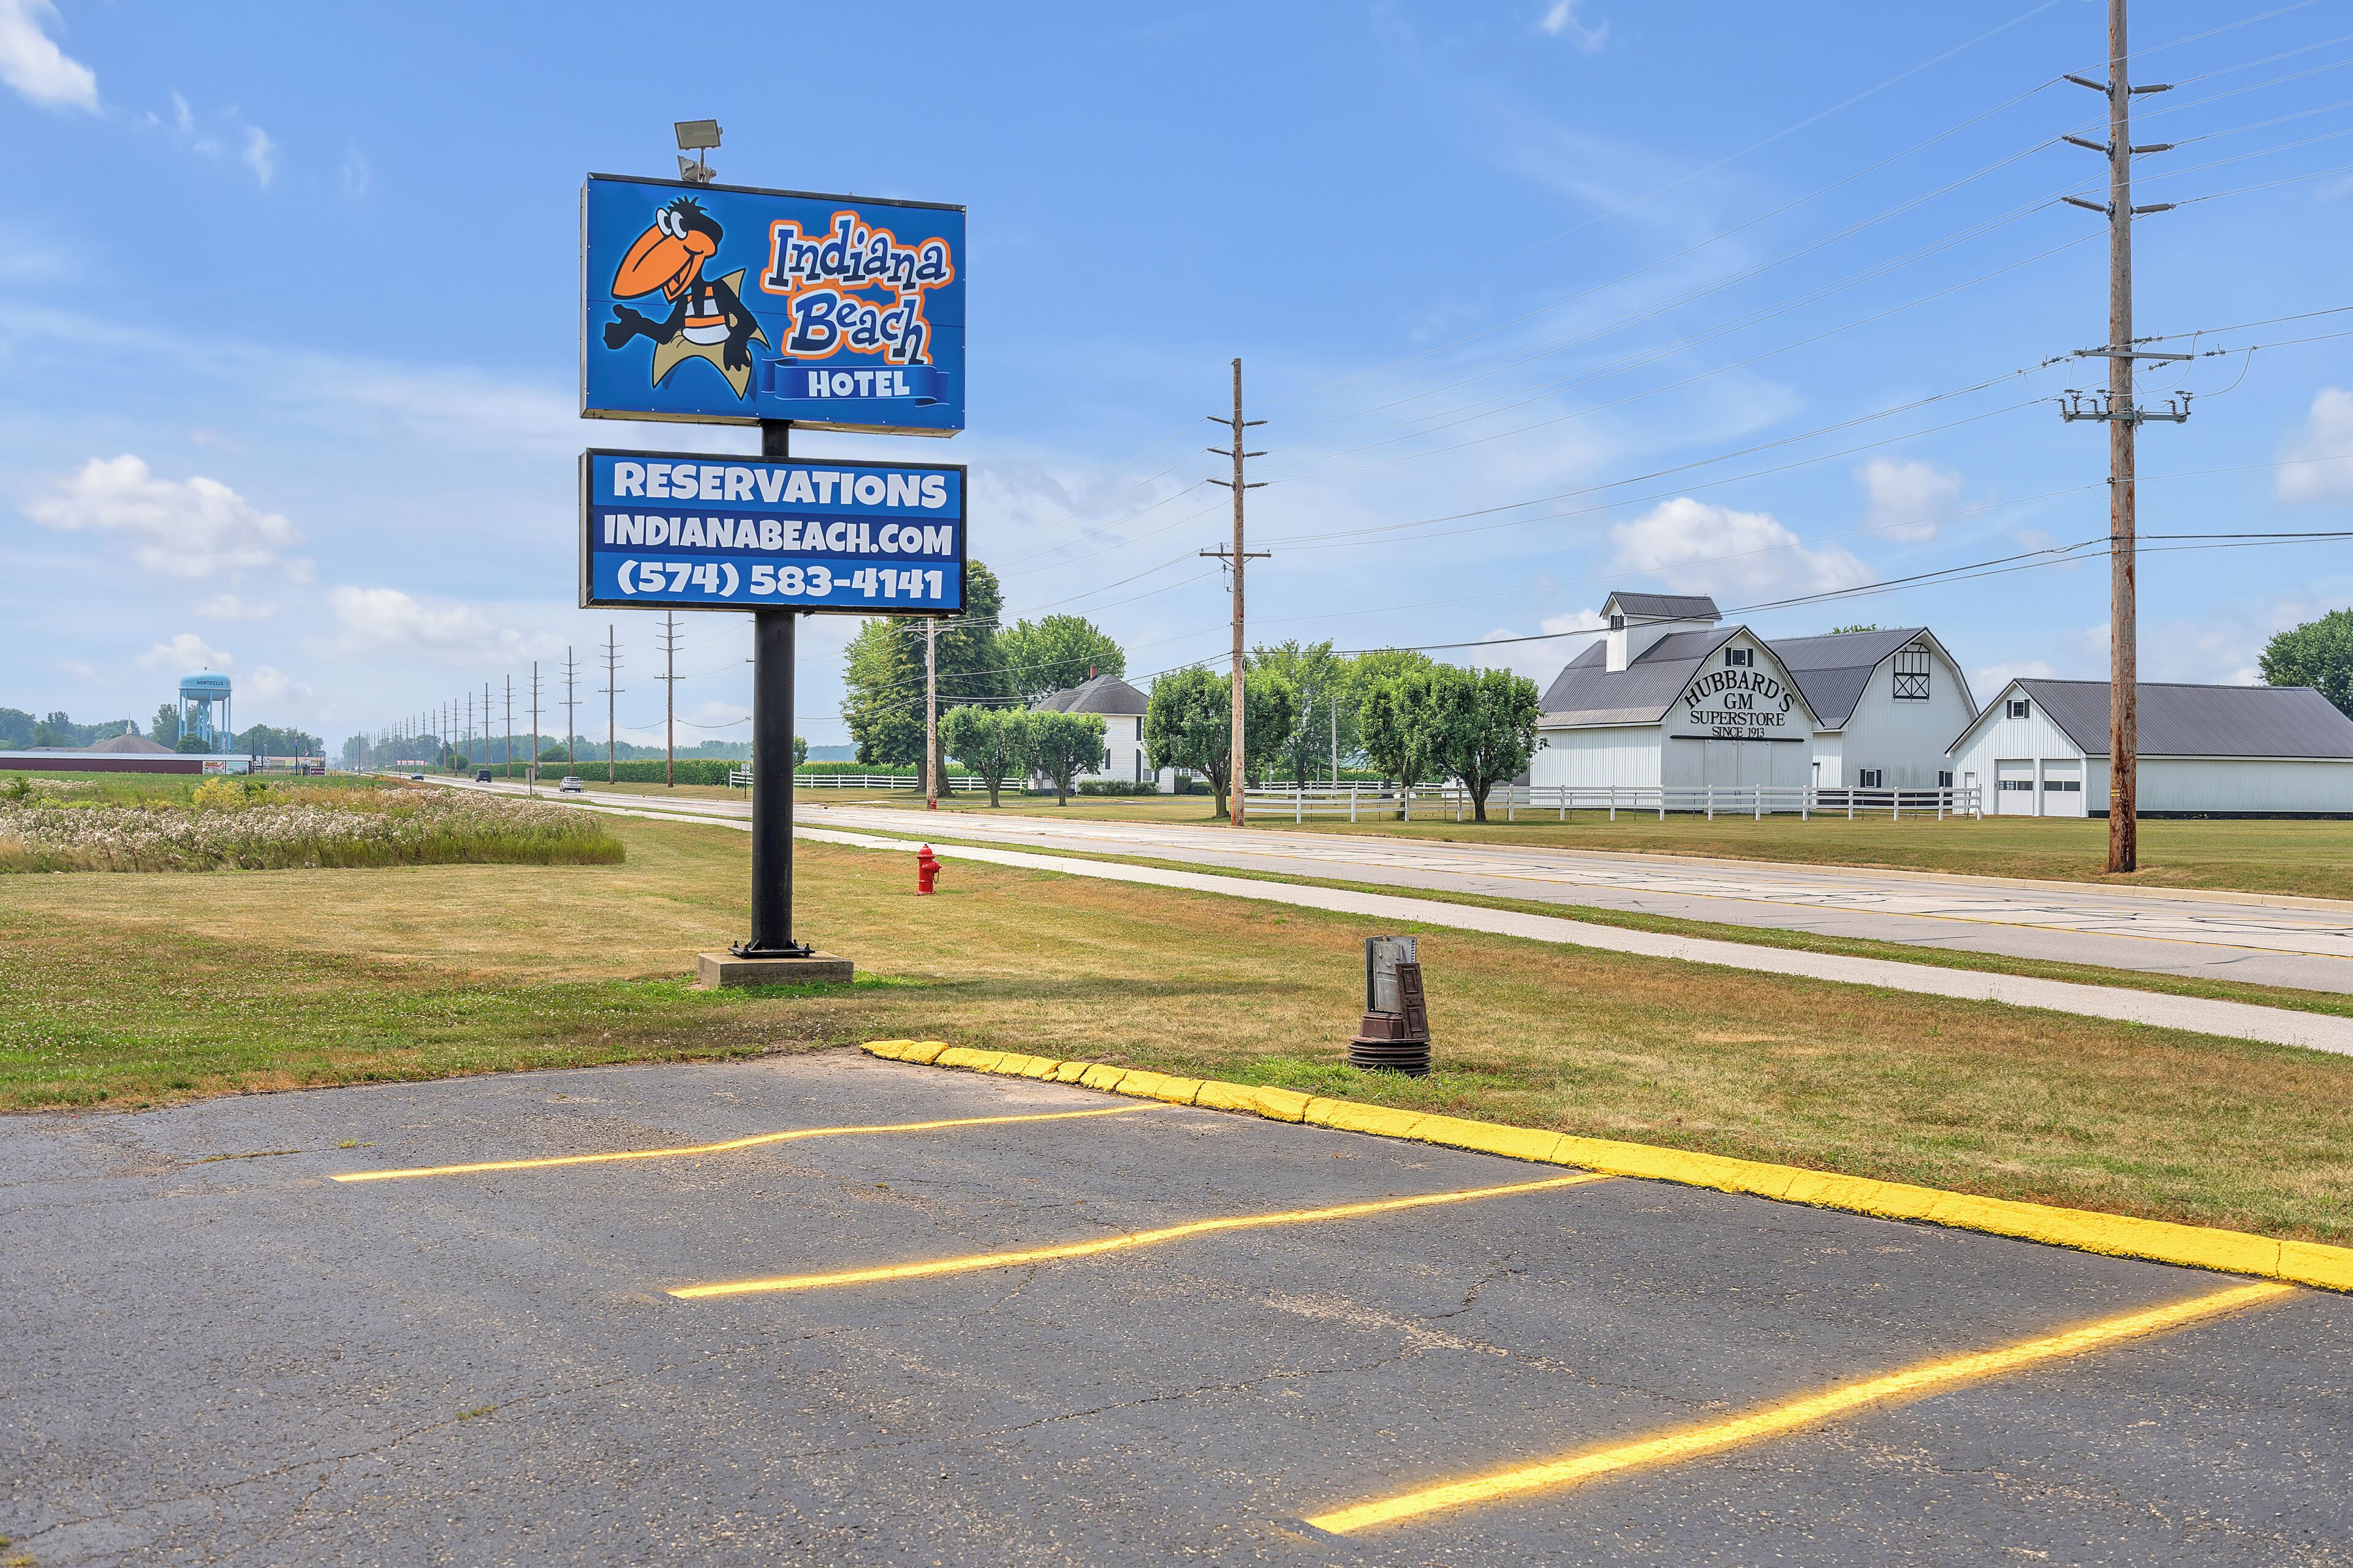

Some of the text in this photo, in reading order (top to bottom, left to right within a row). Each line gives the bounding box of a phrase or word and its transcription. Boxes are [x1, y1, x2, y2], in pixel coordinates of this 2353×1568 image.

[766, 216, 949, 294] Indiana
[787, 289, 928, 365] Beach
[808, 371, 910, 398] HOTEL
[613, 461, 947, 509] RESERVATIONS
[604, 513, 953, 556] INDIANABEACH.COM
[617, 559, 943, 599] (574) 583-4141
[1684, 670, 1795, 713] HUBBARD'S
[1724, 693, 1754, 710] GM
[1690, 711, 1786, 726] SUPERSTORE
[1712, 726, 1765, 738] SINCE 1913
